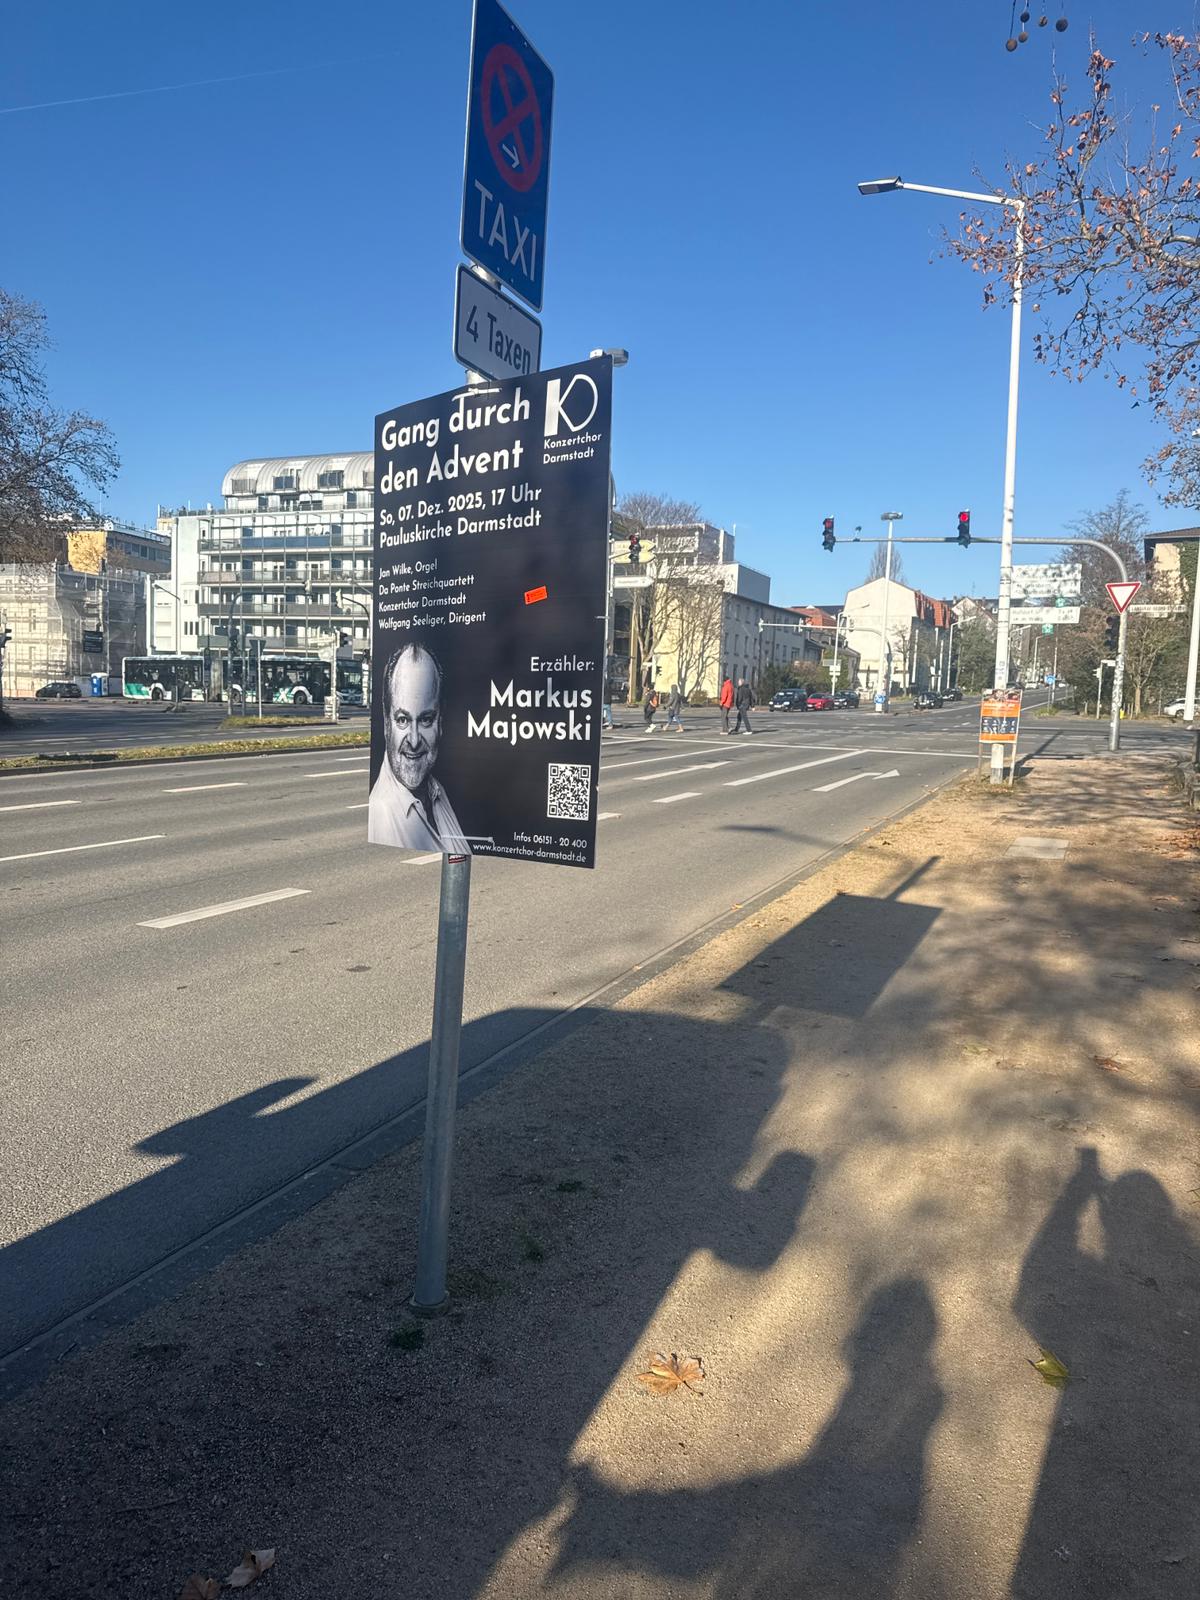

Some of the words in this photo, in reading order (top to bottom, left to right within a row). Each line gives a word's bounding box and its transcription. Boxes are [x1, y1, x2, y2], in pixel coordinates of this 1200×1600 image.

[474, 179, 536, 282] TAXI
[466, 304, 479, 343] 4
[487, 311, 531, 375] Taxen
[381, 419, 440, 451] Gang
[448, 387, 530, 433] durch
[543, 431, 602, 450] Konzertchor
[542, 446, 595, 465] Darmstadt
[380, 460, 418, 495] den
[426, 439, 524, 484] Advent
[379, 509, 396, 526] So,
[398, 504, 415, 522] 07.
[417, 500, 444, 518] Dez.
[447, 491, 486, 513] 2025,
[490, 487, 506, 506] 17
[511, 482, 542, 503] Uhr
[379, 519, 453, 549] Pauluskirche
[457, 507, 542, 535] Darmstadt
[378, 567, 391, 580] Jan
[391, 562, 414, 576] Wilke,
[415, 558, 438, 574] Orgel
[378, 585, 389, 596] Da
[390, 581, 411, 594] Ponte
[412, 574, 475, 591] Streichquartett
[378, 597, 419, 613] Konzertchor
[421, 592, 467, 607] Darmstadt
[378, 617, 411, 631] Wolfgang
[412, 613, 446, 627] Seeliger,
[448, 611, 486, 625] Dirigent
[530, 654, 595, 672] Erzähler:
[490, 677, 593, 709] Markus
[467, 709, 592, 746] Majowski
[473, 841, 587, 862] www.konzertchor-darmstadt.de
[513, 832, 532, 843] Infos
[533, 834, 553, 845] 06151
[559, 837, 570, 847] 20
[571, 839, 588, 849] 400
